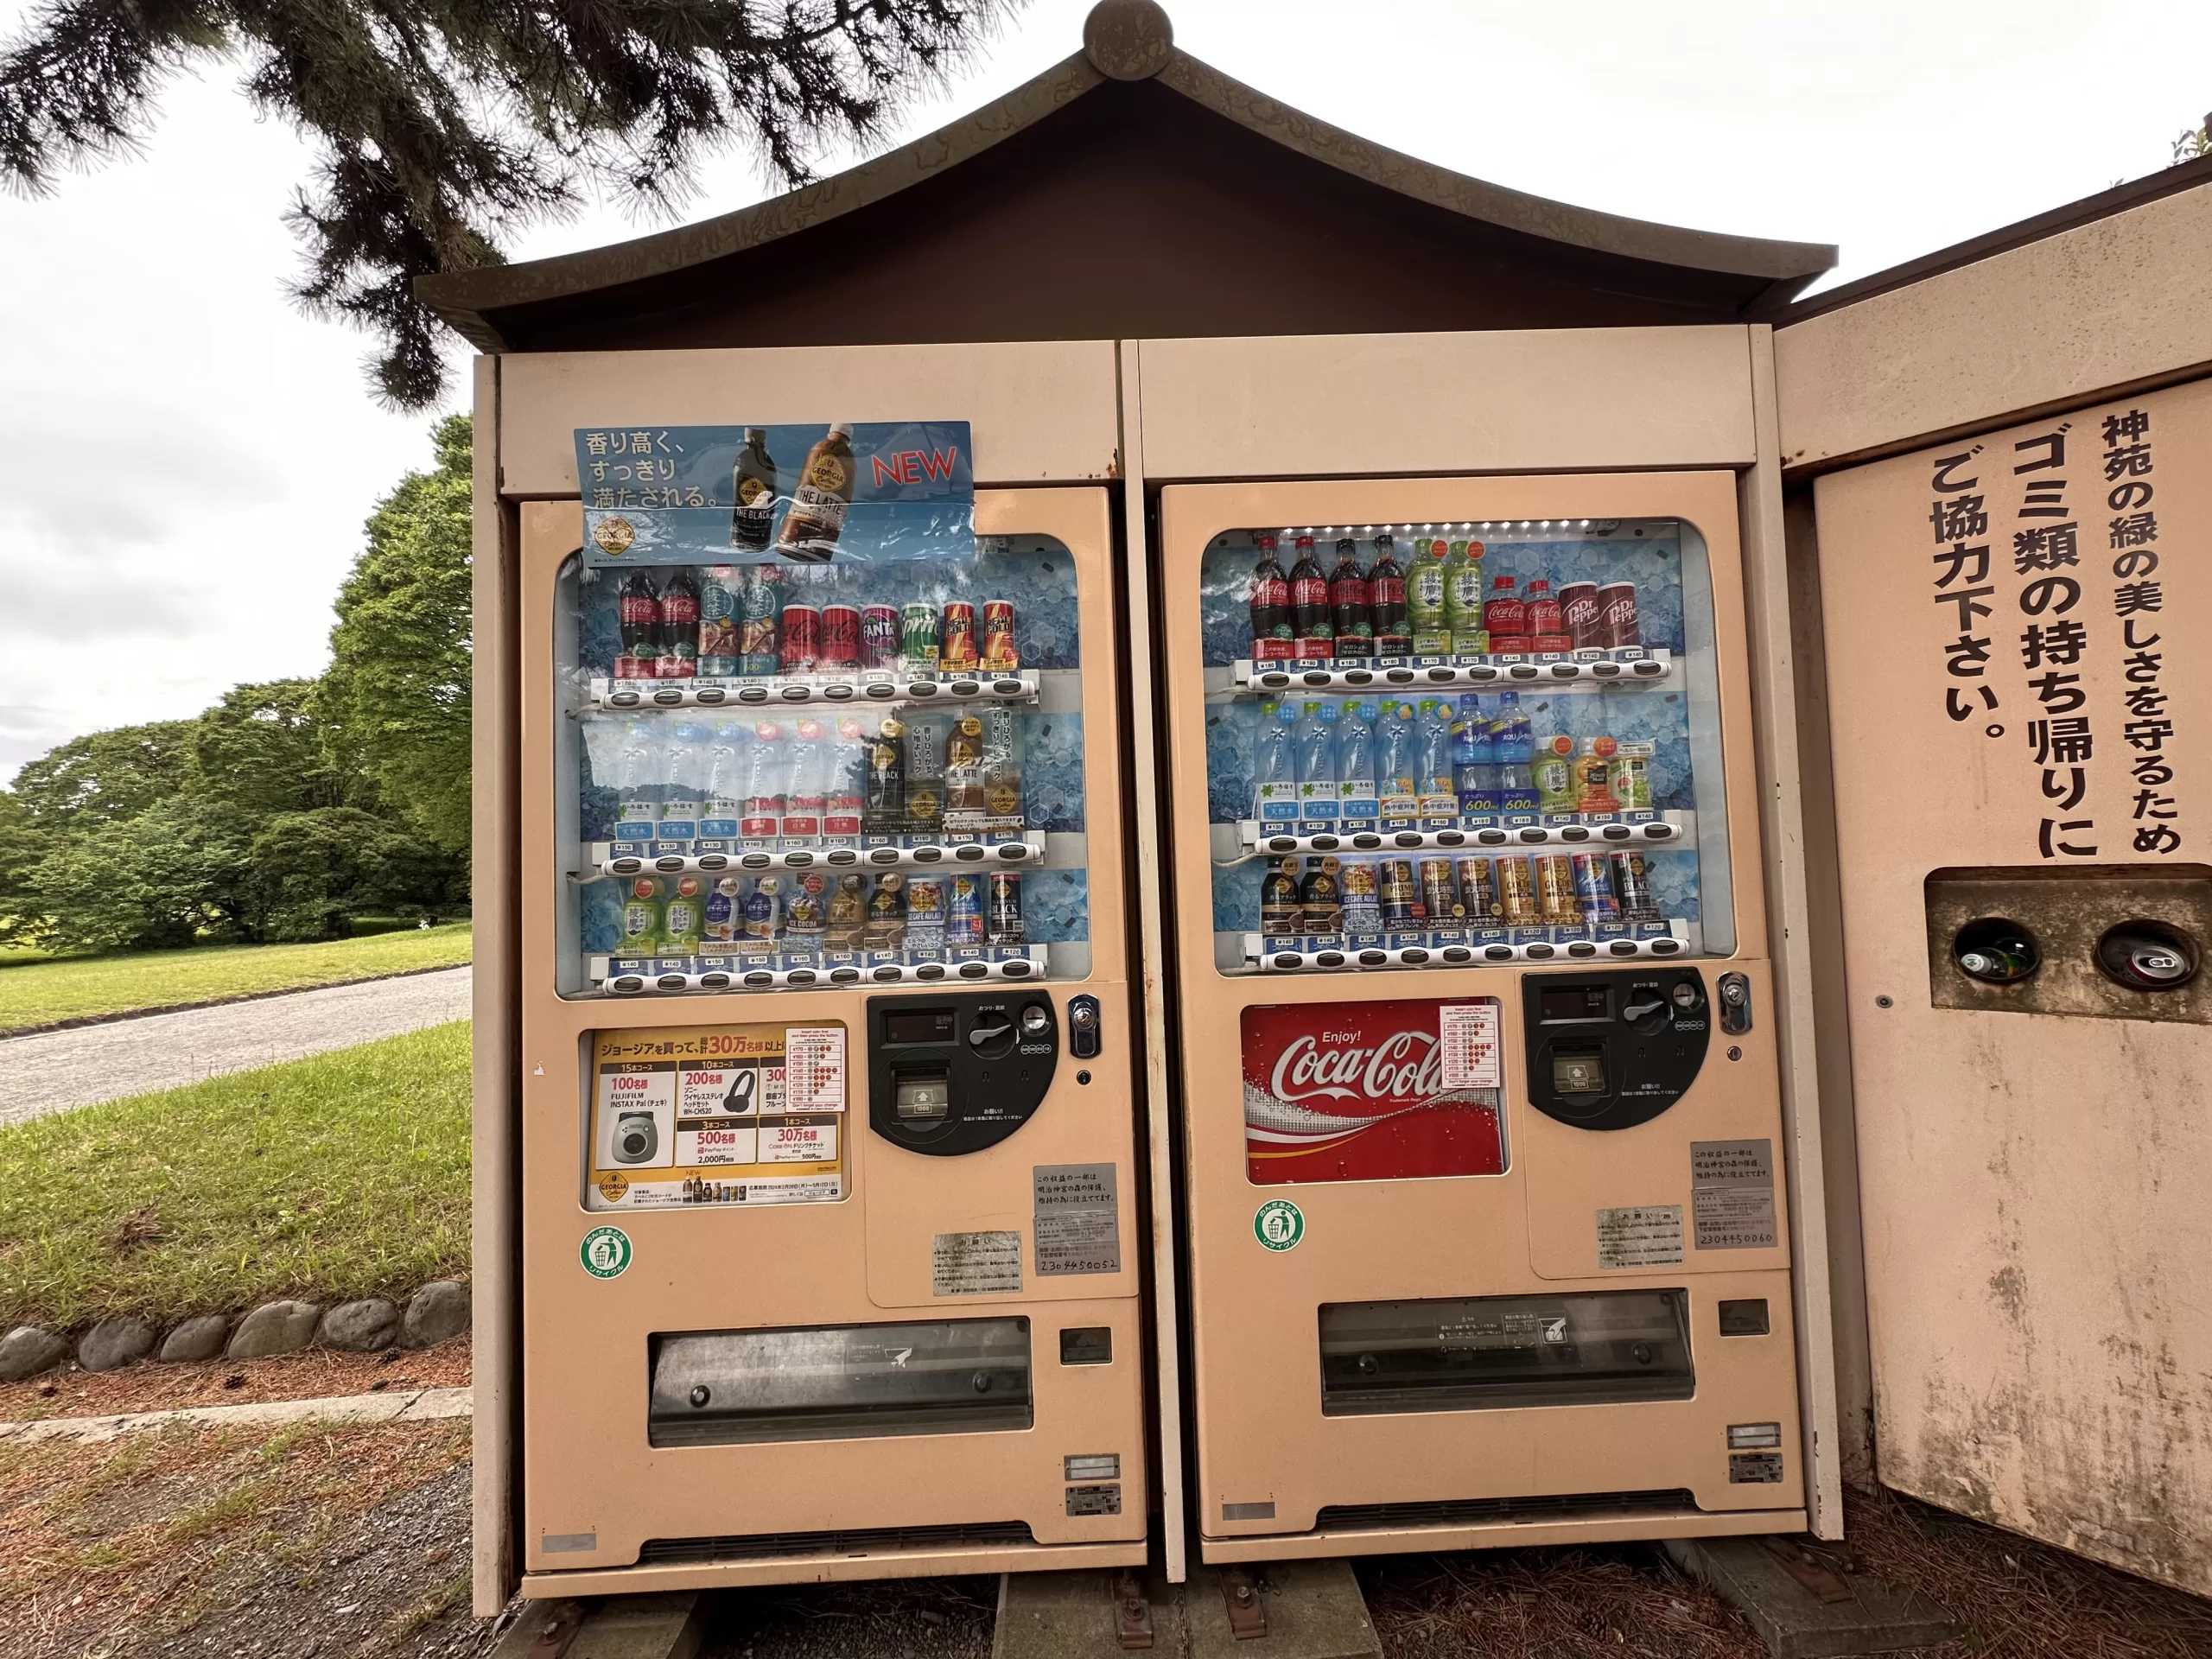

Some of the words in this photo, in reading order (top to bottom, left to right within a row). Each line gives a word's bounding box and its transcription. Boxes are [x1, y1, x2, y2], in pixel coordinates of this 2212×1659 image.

[586, 431, 684, 454] 香り高く、
[589, 459, 677, 482] すっきり
[871, 446, 957, 487] NEW
[811, 467, 844, 484] GEORGIA
[593, 486, 718, 509] 満たされる。
[799, 489, 816, 503] THE
[816, 493, 843, 515] LATTE
[736, 507, 747, 518] THE
[748, 510, 771, 520] BLACK
[1425, 572, 1436, 598] 綾鷹
[1461, 572, 1473, 598] 綾鷹
[1929, 444, 2005, 740] ご協力下さい。
[1579, 600, 1593, 612] Dr
[1620, 600, 1634, 611] Dr
[947, 614, 972, 627] REAL
[987, 614, 1012, 626] REAL
[863, 620, 895, 639] FANTA
[946, 623, 970, 637] GOLD
[986, 622, 1010, 637] GOLD
[2101, 409, 2182, 855] 神苑の緑の美しさを守るため
[2012, 422, 2098, 859] ゴミ類の持ち帰りに
[1002, 711, 1012, 762] 香りひろがる、
[912, 726, 923, 776] 心地よいコク。
[923, 726, 934, 777] 香りひろがる、
[1310, 806, 1334, 815] 天然水
[1465, 800, 1500, 811] 600ml
[1504, 799, 1540, 810] 600ml
[797, 919, 817, 928] COCOA
[1321, 1030, 1362, 1045] Enjoy!
[620, 1064, 653, 1072] 15本コース
[702, 1060, 734, 1070] 10本コース
[611, 1077, 648, 1090] 100名様
[684, 1071, 723, 1085] 200名様
[683, 1092, 724, 1101] ワイヤレスステレオ
[702, 1121, 731, 1130] 3本コース
[784, 1117, 810, 1126] 1本コース
[696, 1130, 736, 1146] 500名様
[777, 1127, 817, 1142] 30万名様
[1694, 1148, 1753, 1158] この収益の一部は
[685, 1168, 702, 1177] NEW
[1037, 1173, 1096, 1183] この収益の一部は
[1037, 1183, 1107, 1193] 明治神宮の森の保護、
[1038, 1193, 1115, 1205] 維持の為に役立ててます。
[1259, 1201, 1299, 1217] のんだあとは
[586, 1228, 626, 1245] のんだあとは
[1262, 1237, 1296, 1249] リサイクル
[1700, 1233, 1773, 1244] 2304450060
[588, 1264, 624, 1277] リサイクル
[1040, 1259, 1118, 1271] 2304450052
